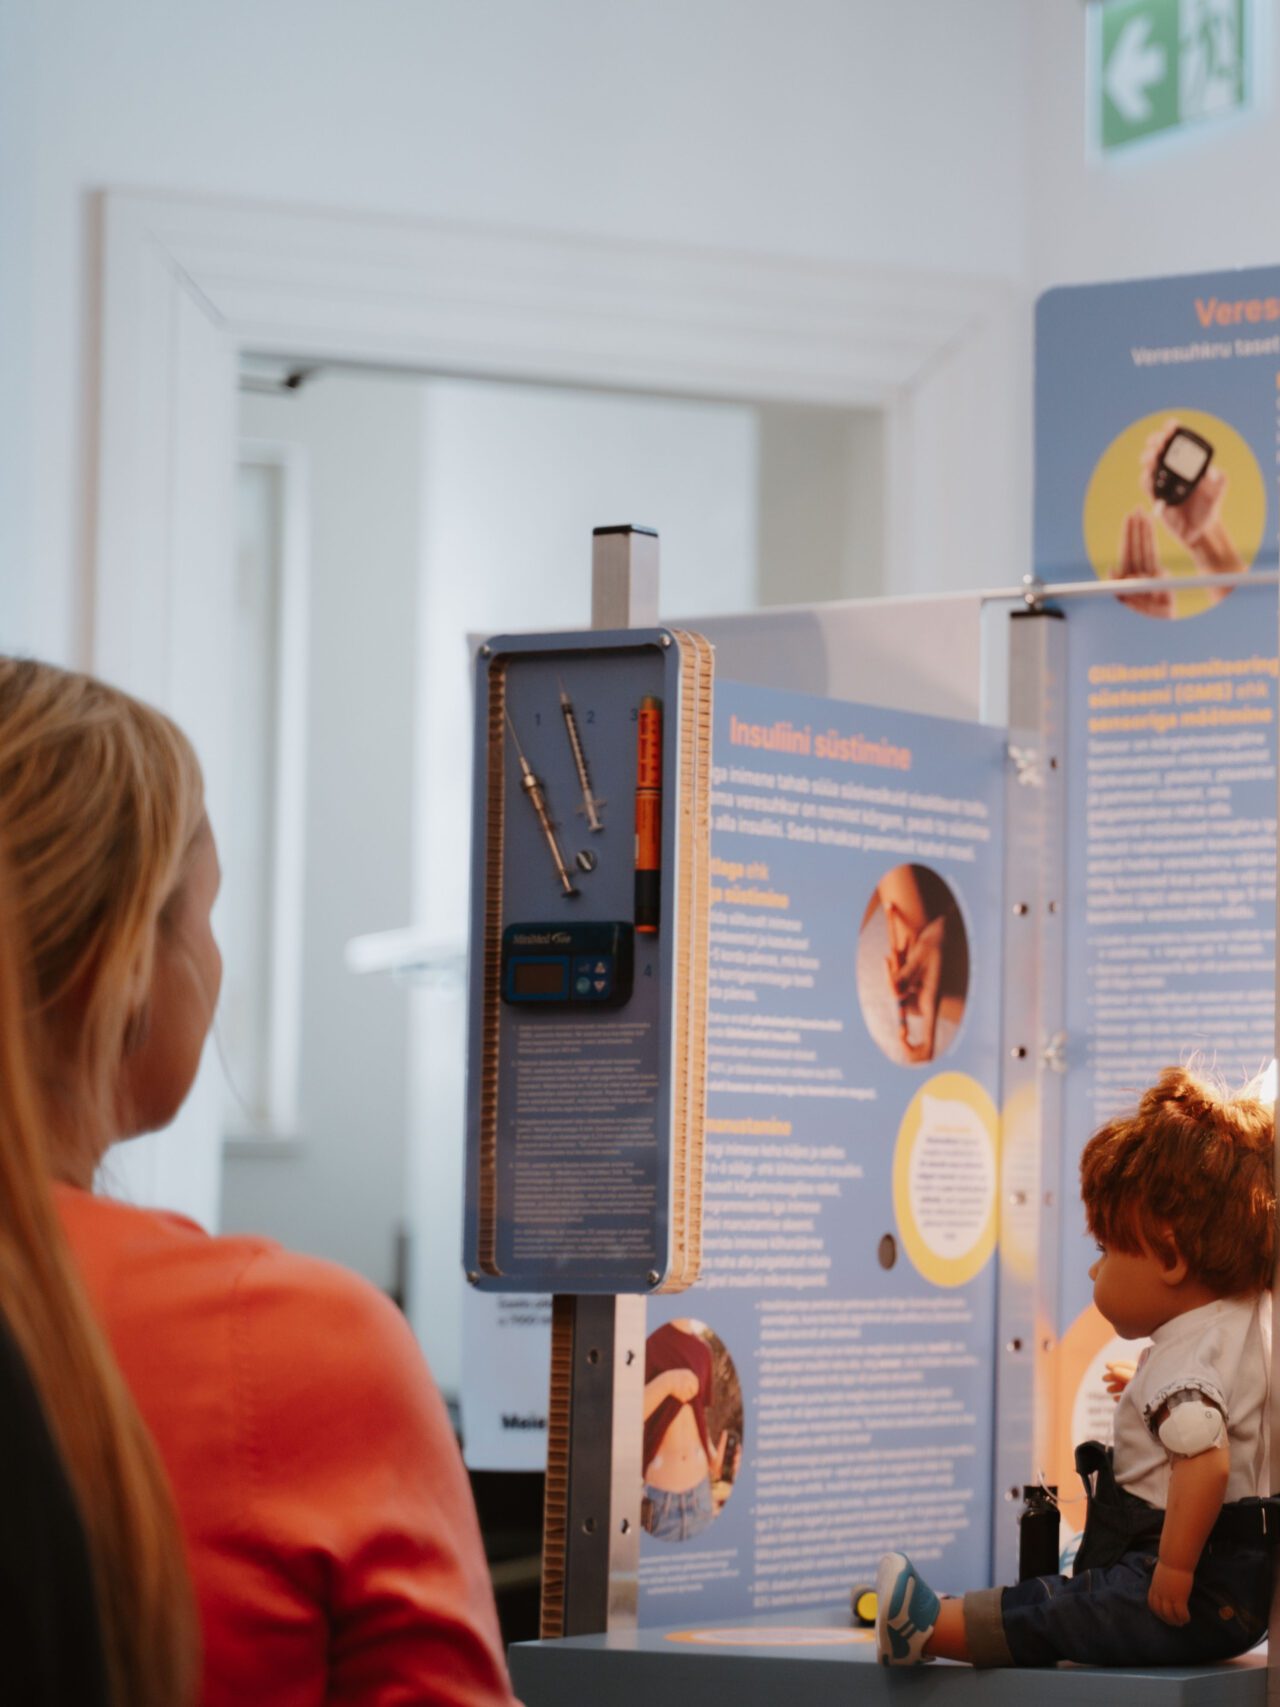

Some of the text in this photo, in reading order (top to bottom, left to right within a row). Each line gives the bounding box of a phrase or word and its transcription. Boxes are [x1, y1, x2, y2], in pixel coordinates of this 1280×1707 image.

[1132, 341, 1232, 366] Veresuhkru
[1235, 335, 1280, 357] taset
[587, 711, 595, 724] 2
[729, 714, 912, 770] Insuliini süstimine
